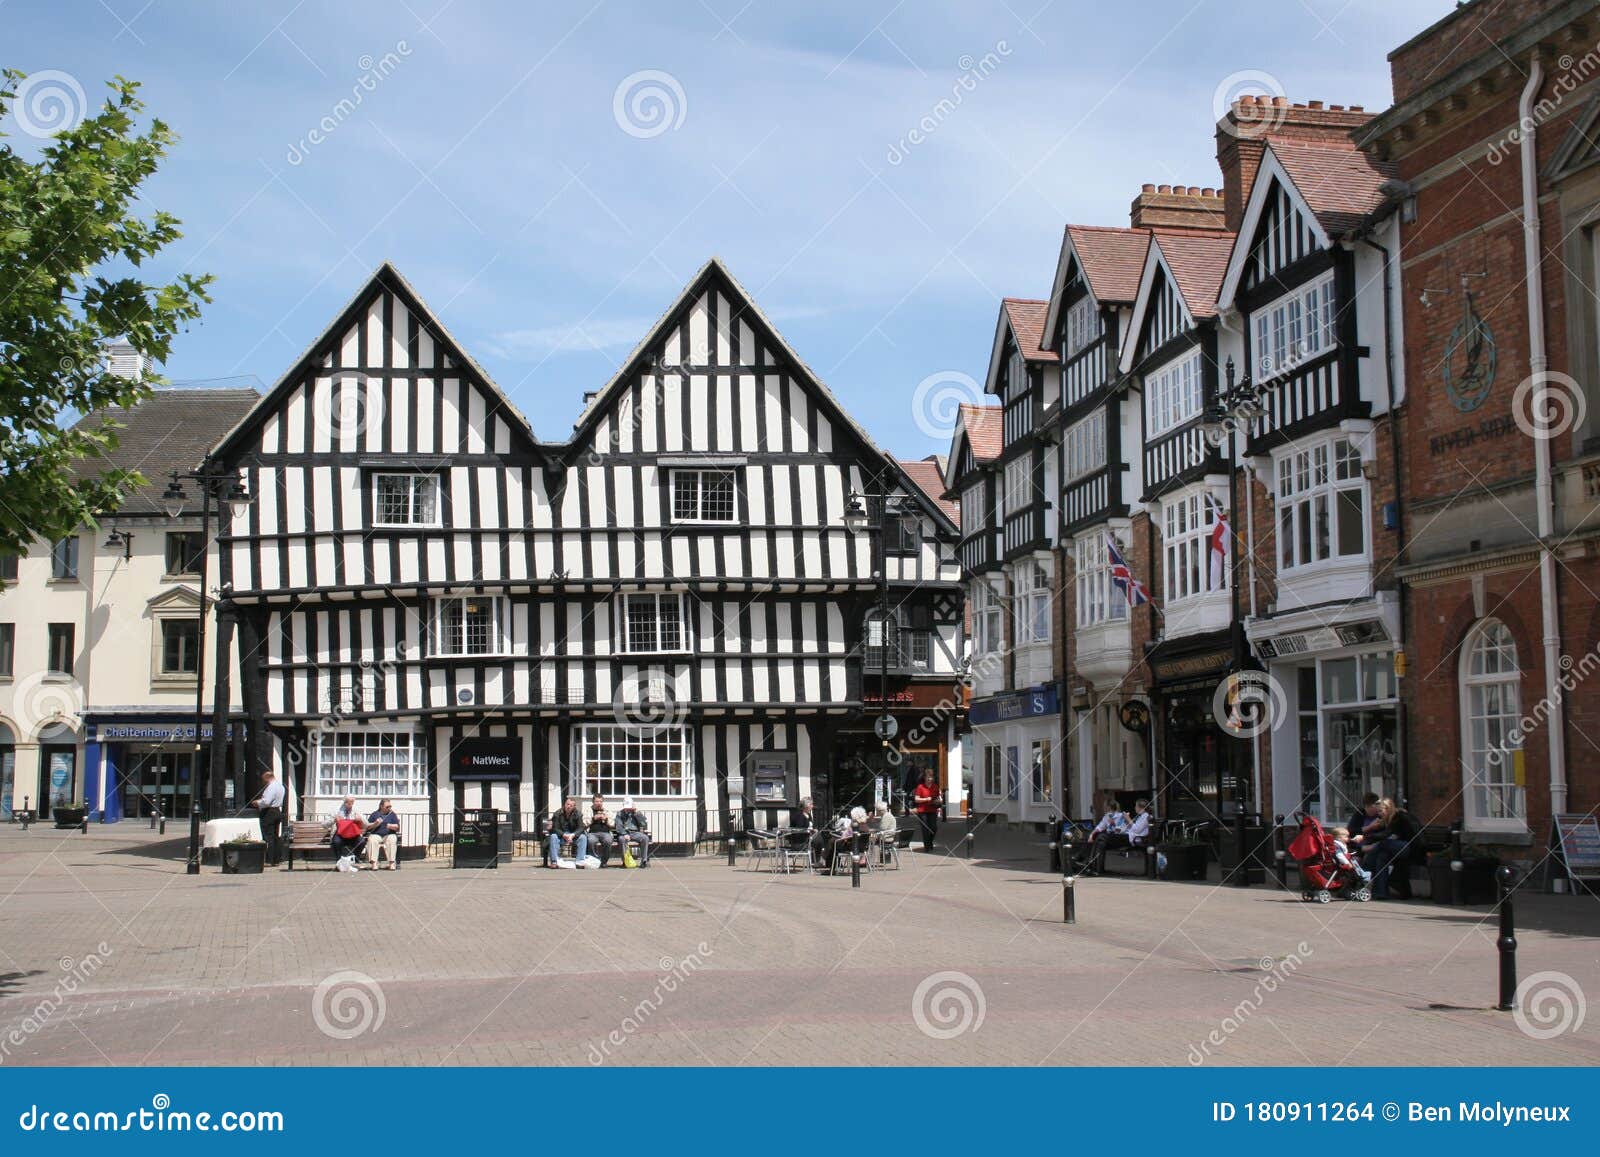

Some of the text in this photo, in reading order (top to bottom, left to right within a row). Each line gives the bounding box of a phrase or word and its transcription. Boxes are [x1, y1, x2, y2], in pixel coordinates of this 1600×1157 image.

[104, 726, 170, 738] Cheltenham
[173, 727, 184, 738] &
[472, 755, 510, 765] NatWest
